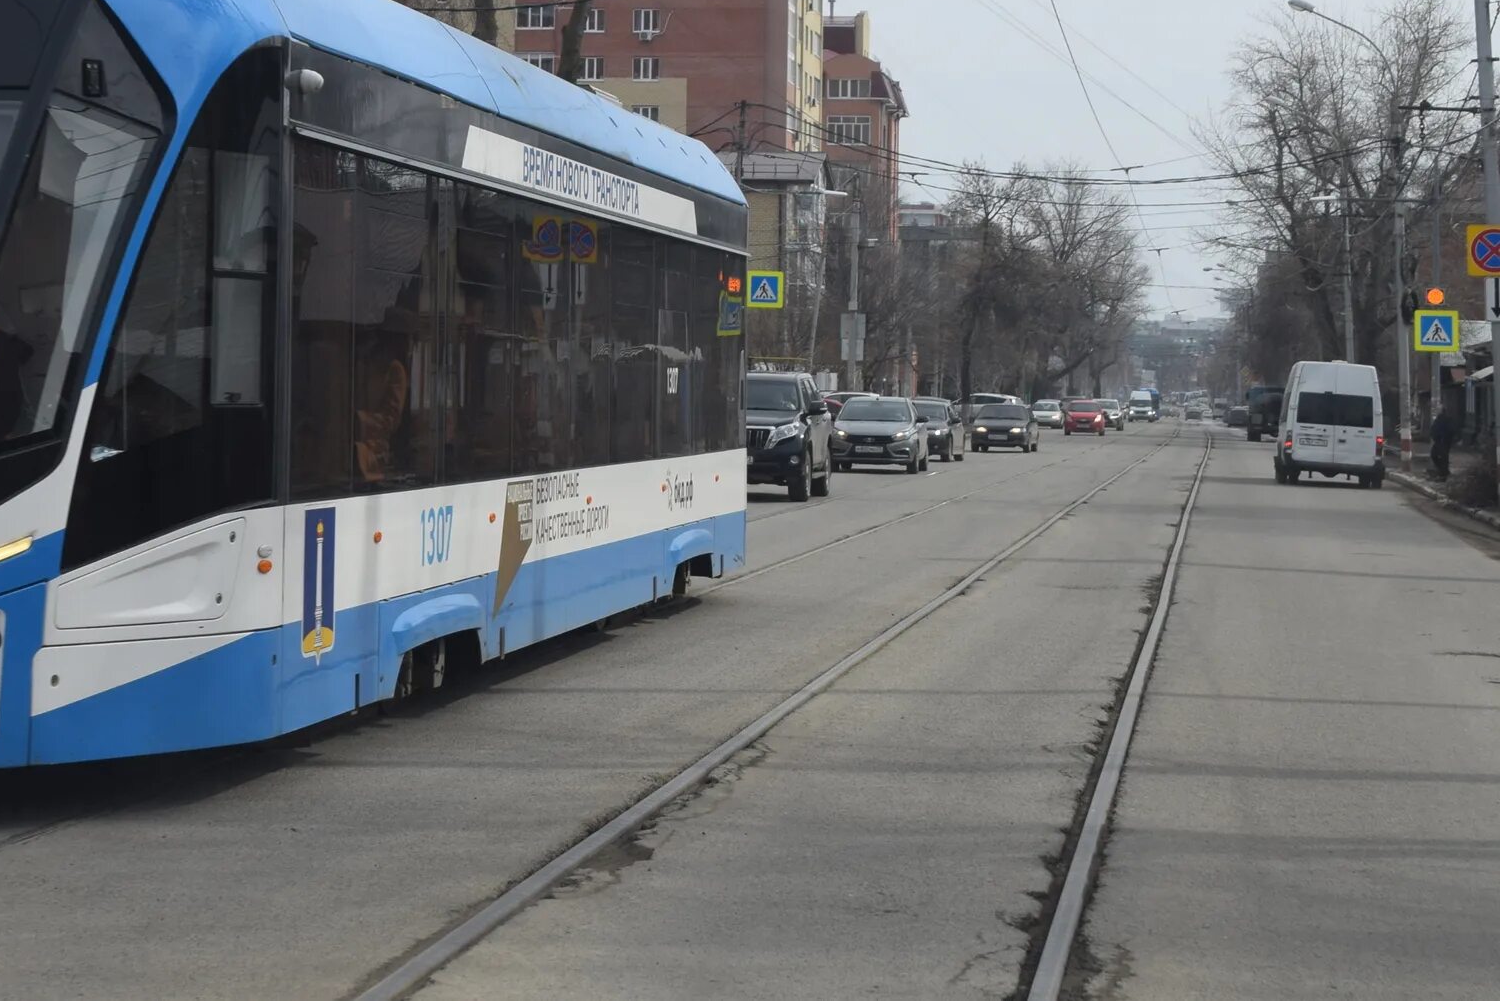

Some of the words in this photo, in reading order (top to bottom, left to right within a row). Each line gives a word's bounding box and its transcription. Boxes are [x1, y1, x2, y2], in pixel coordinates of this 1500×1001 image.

[523, 145, 554, 190] ВРЕМЯ
[555, 156, 590, 200] НОВОГО
[592, 170, 639, 215] ТРАНСПОРТА
[536, 472, 580, 504] БЕЗОПАСНЫЕ
[421, 506, 453, 566] 1307
[535, 509, 585, 544] КАЧЕСТВЕННЫЕ
[585, 504, 610, 538] ДОРОГИ
